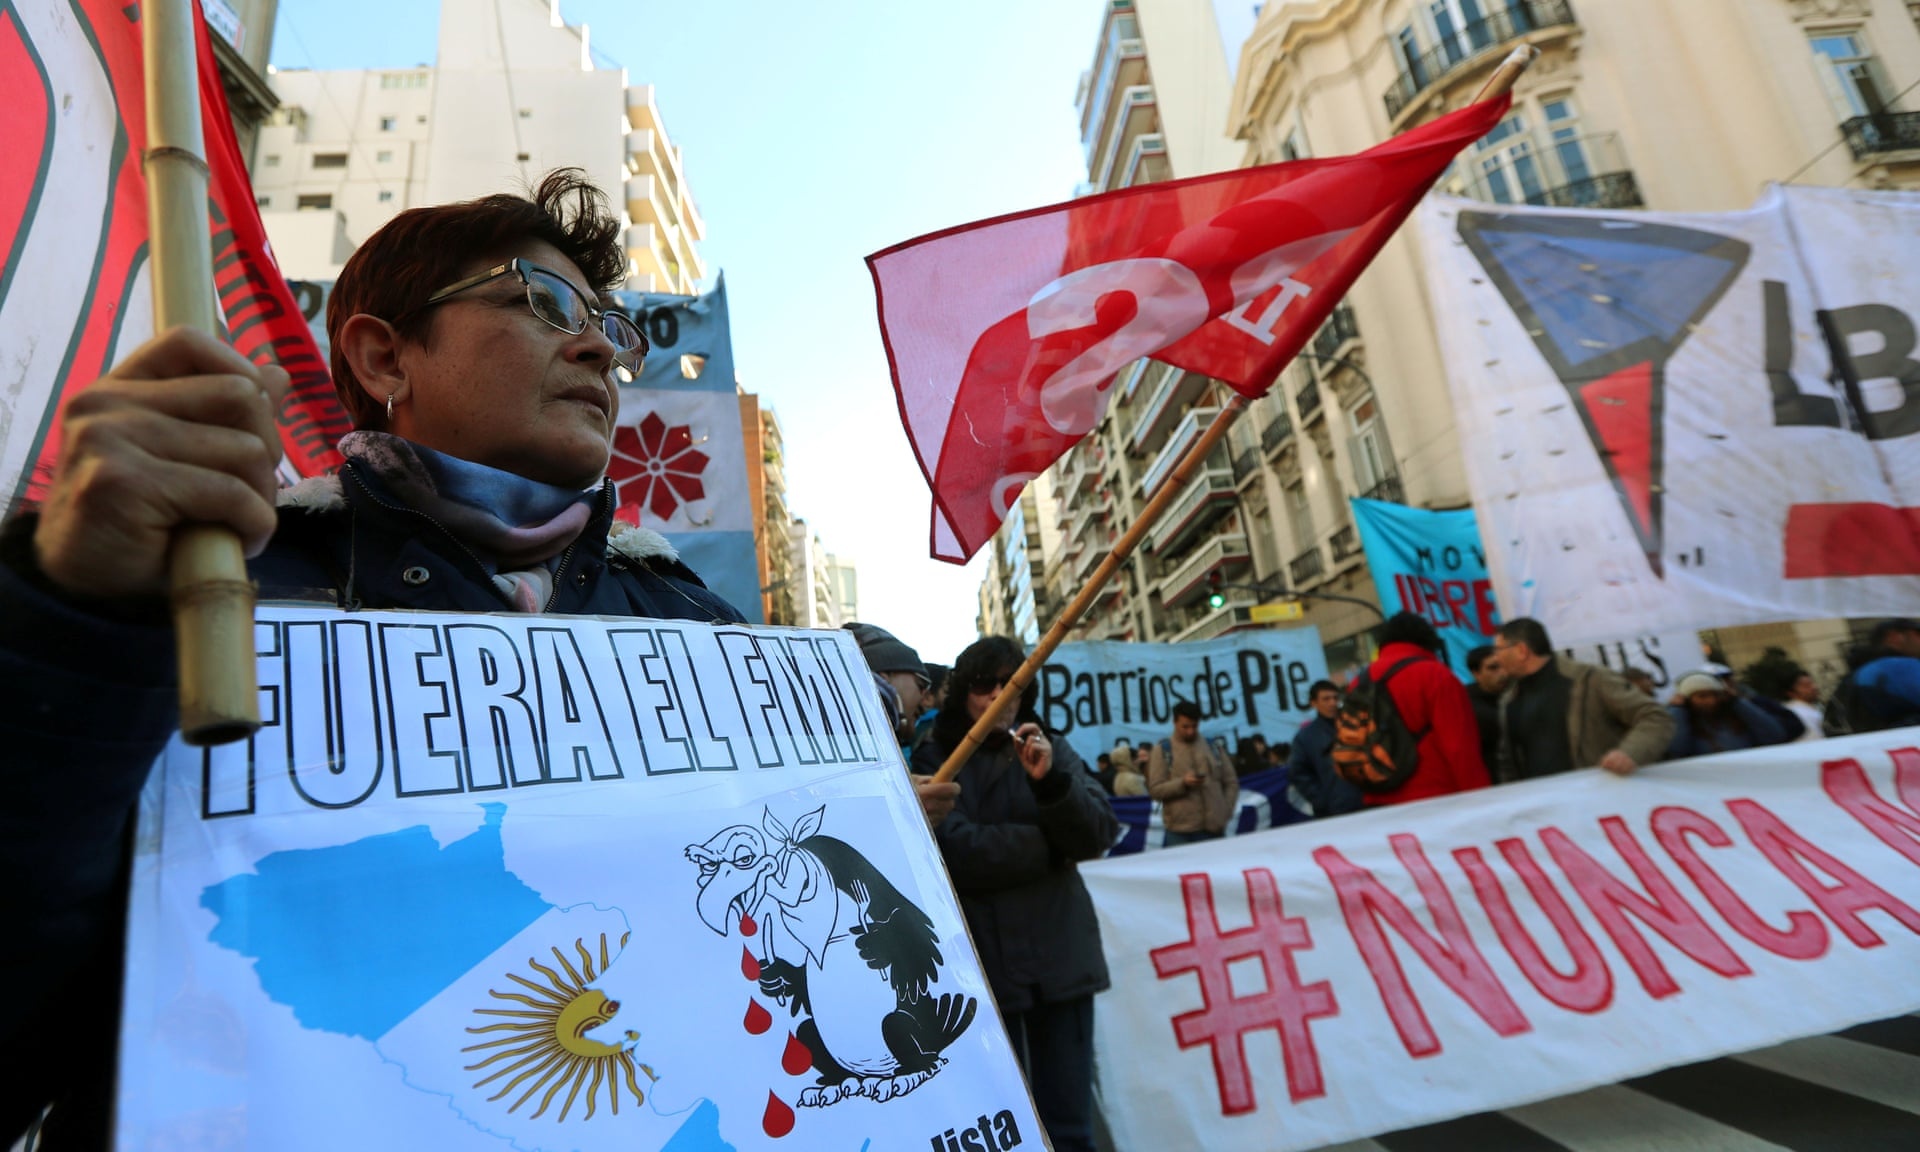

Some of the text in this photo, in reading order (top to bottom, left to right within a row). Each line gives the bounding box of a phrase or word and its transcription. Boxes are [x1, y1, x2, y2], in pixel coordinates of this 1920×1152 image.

[202, 618, 879, 820] FUERA EL FMI
[1041, 649, 1314, 737] Barrios de Pie
[1150, 797, 1920, 1118] #NUNCA
